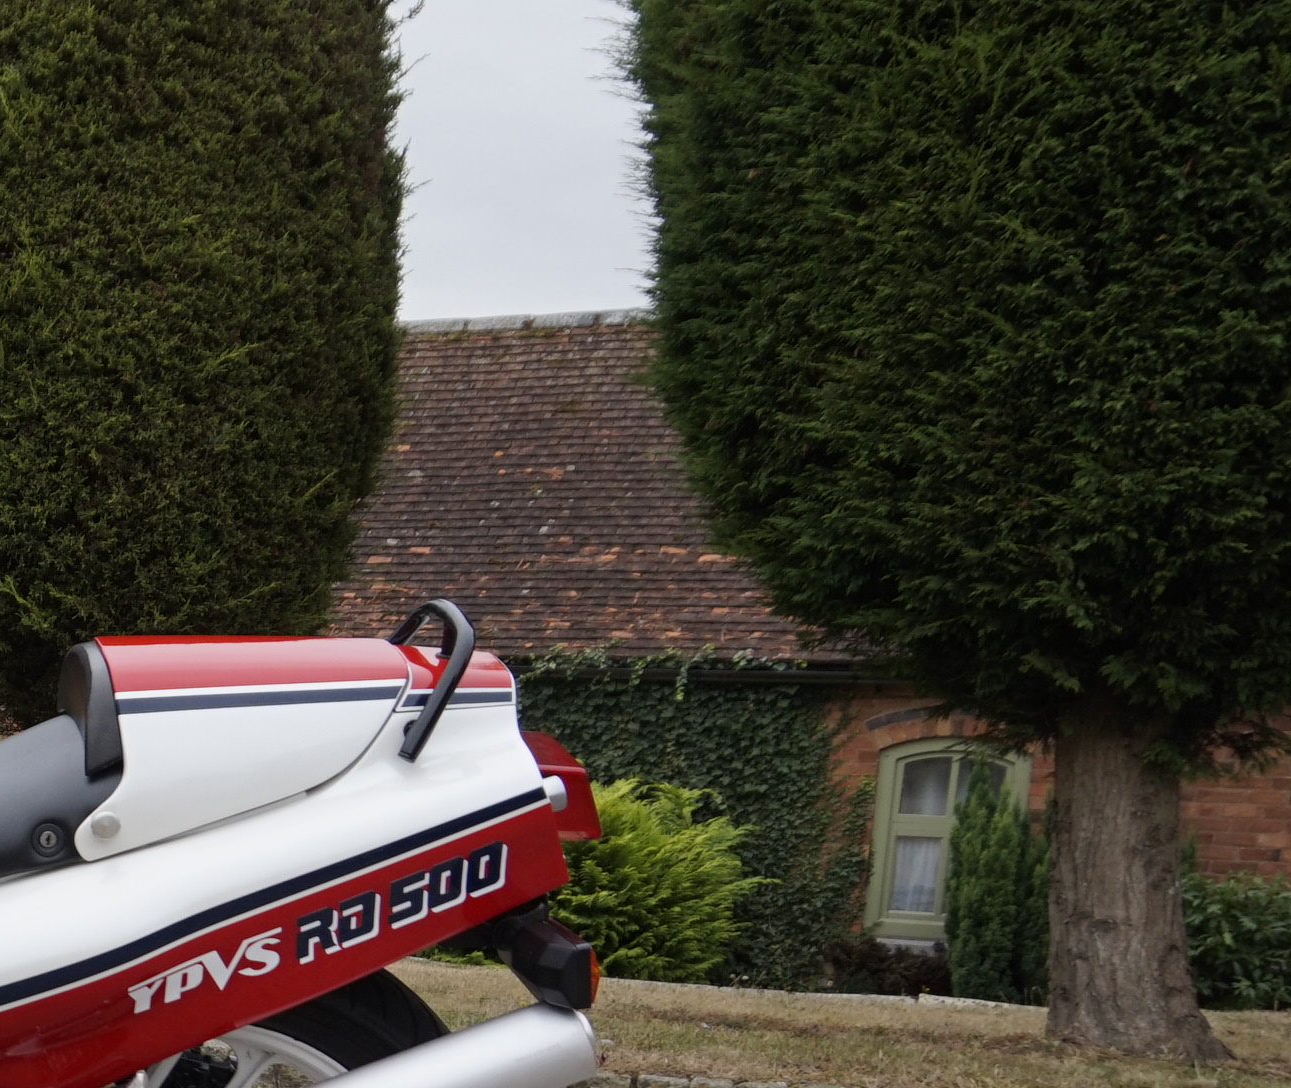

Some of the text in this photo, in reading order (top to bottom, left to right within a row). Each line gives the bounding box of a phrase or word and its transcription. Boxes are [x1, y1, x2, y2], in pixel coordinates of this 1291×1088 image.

[127, 841, 508, 1014] YPVS RD 500
